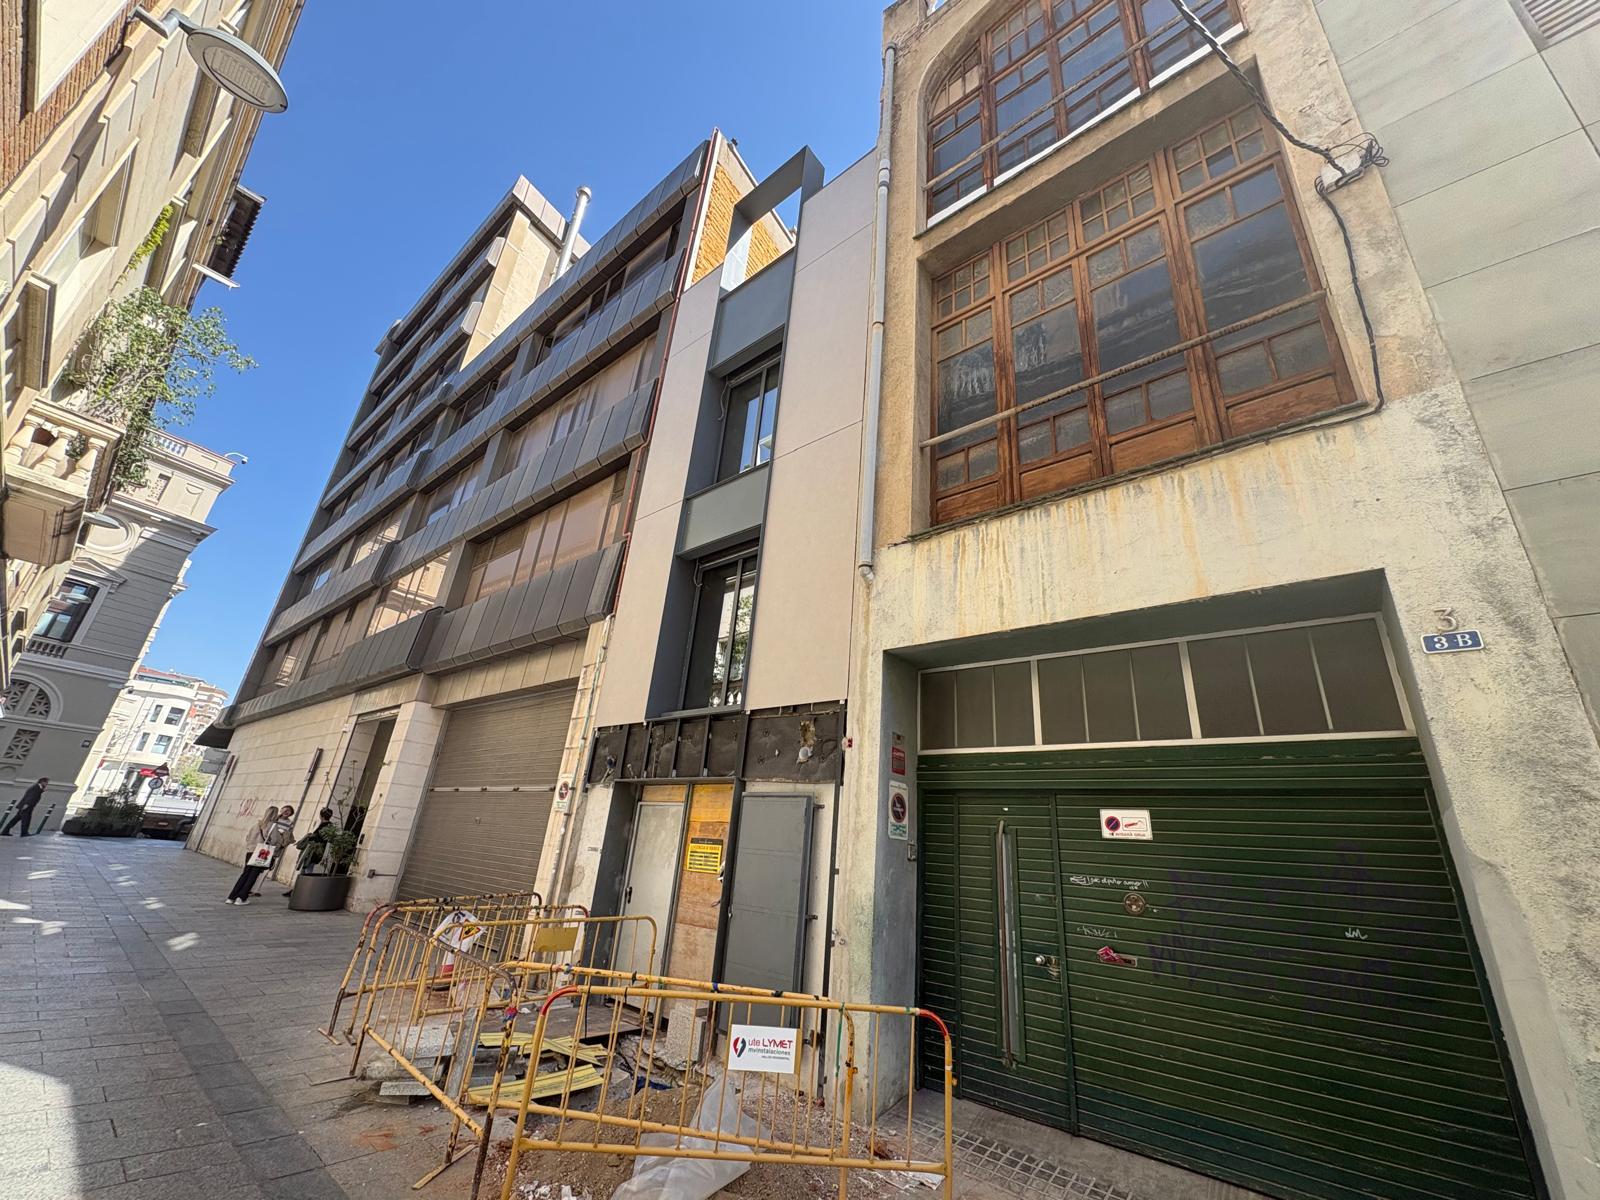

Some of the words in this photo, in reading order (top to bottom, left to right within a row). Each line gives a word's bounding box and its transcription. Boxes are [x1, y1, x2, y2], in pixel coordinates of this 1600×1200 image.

[1434, 607, 1457, 631] 3
[748, 1038, 760, 1047] ute
[762, 1037, 794, 1049] LYMET
